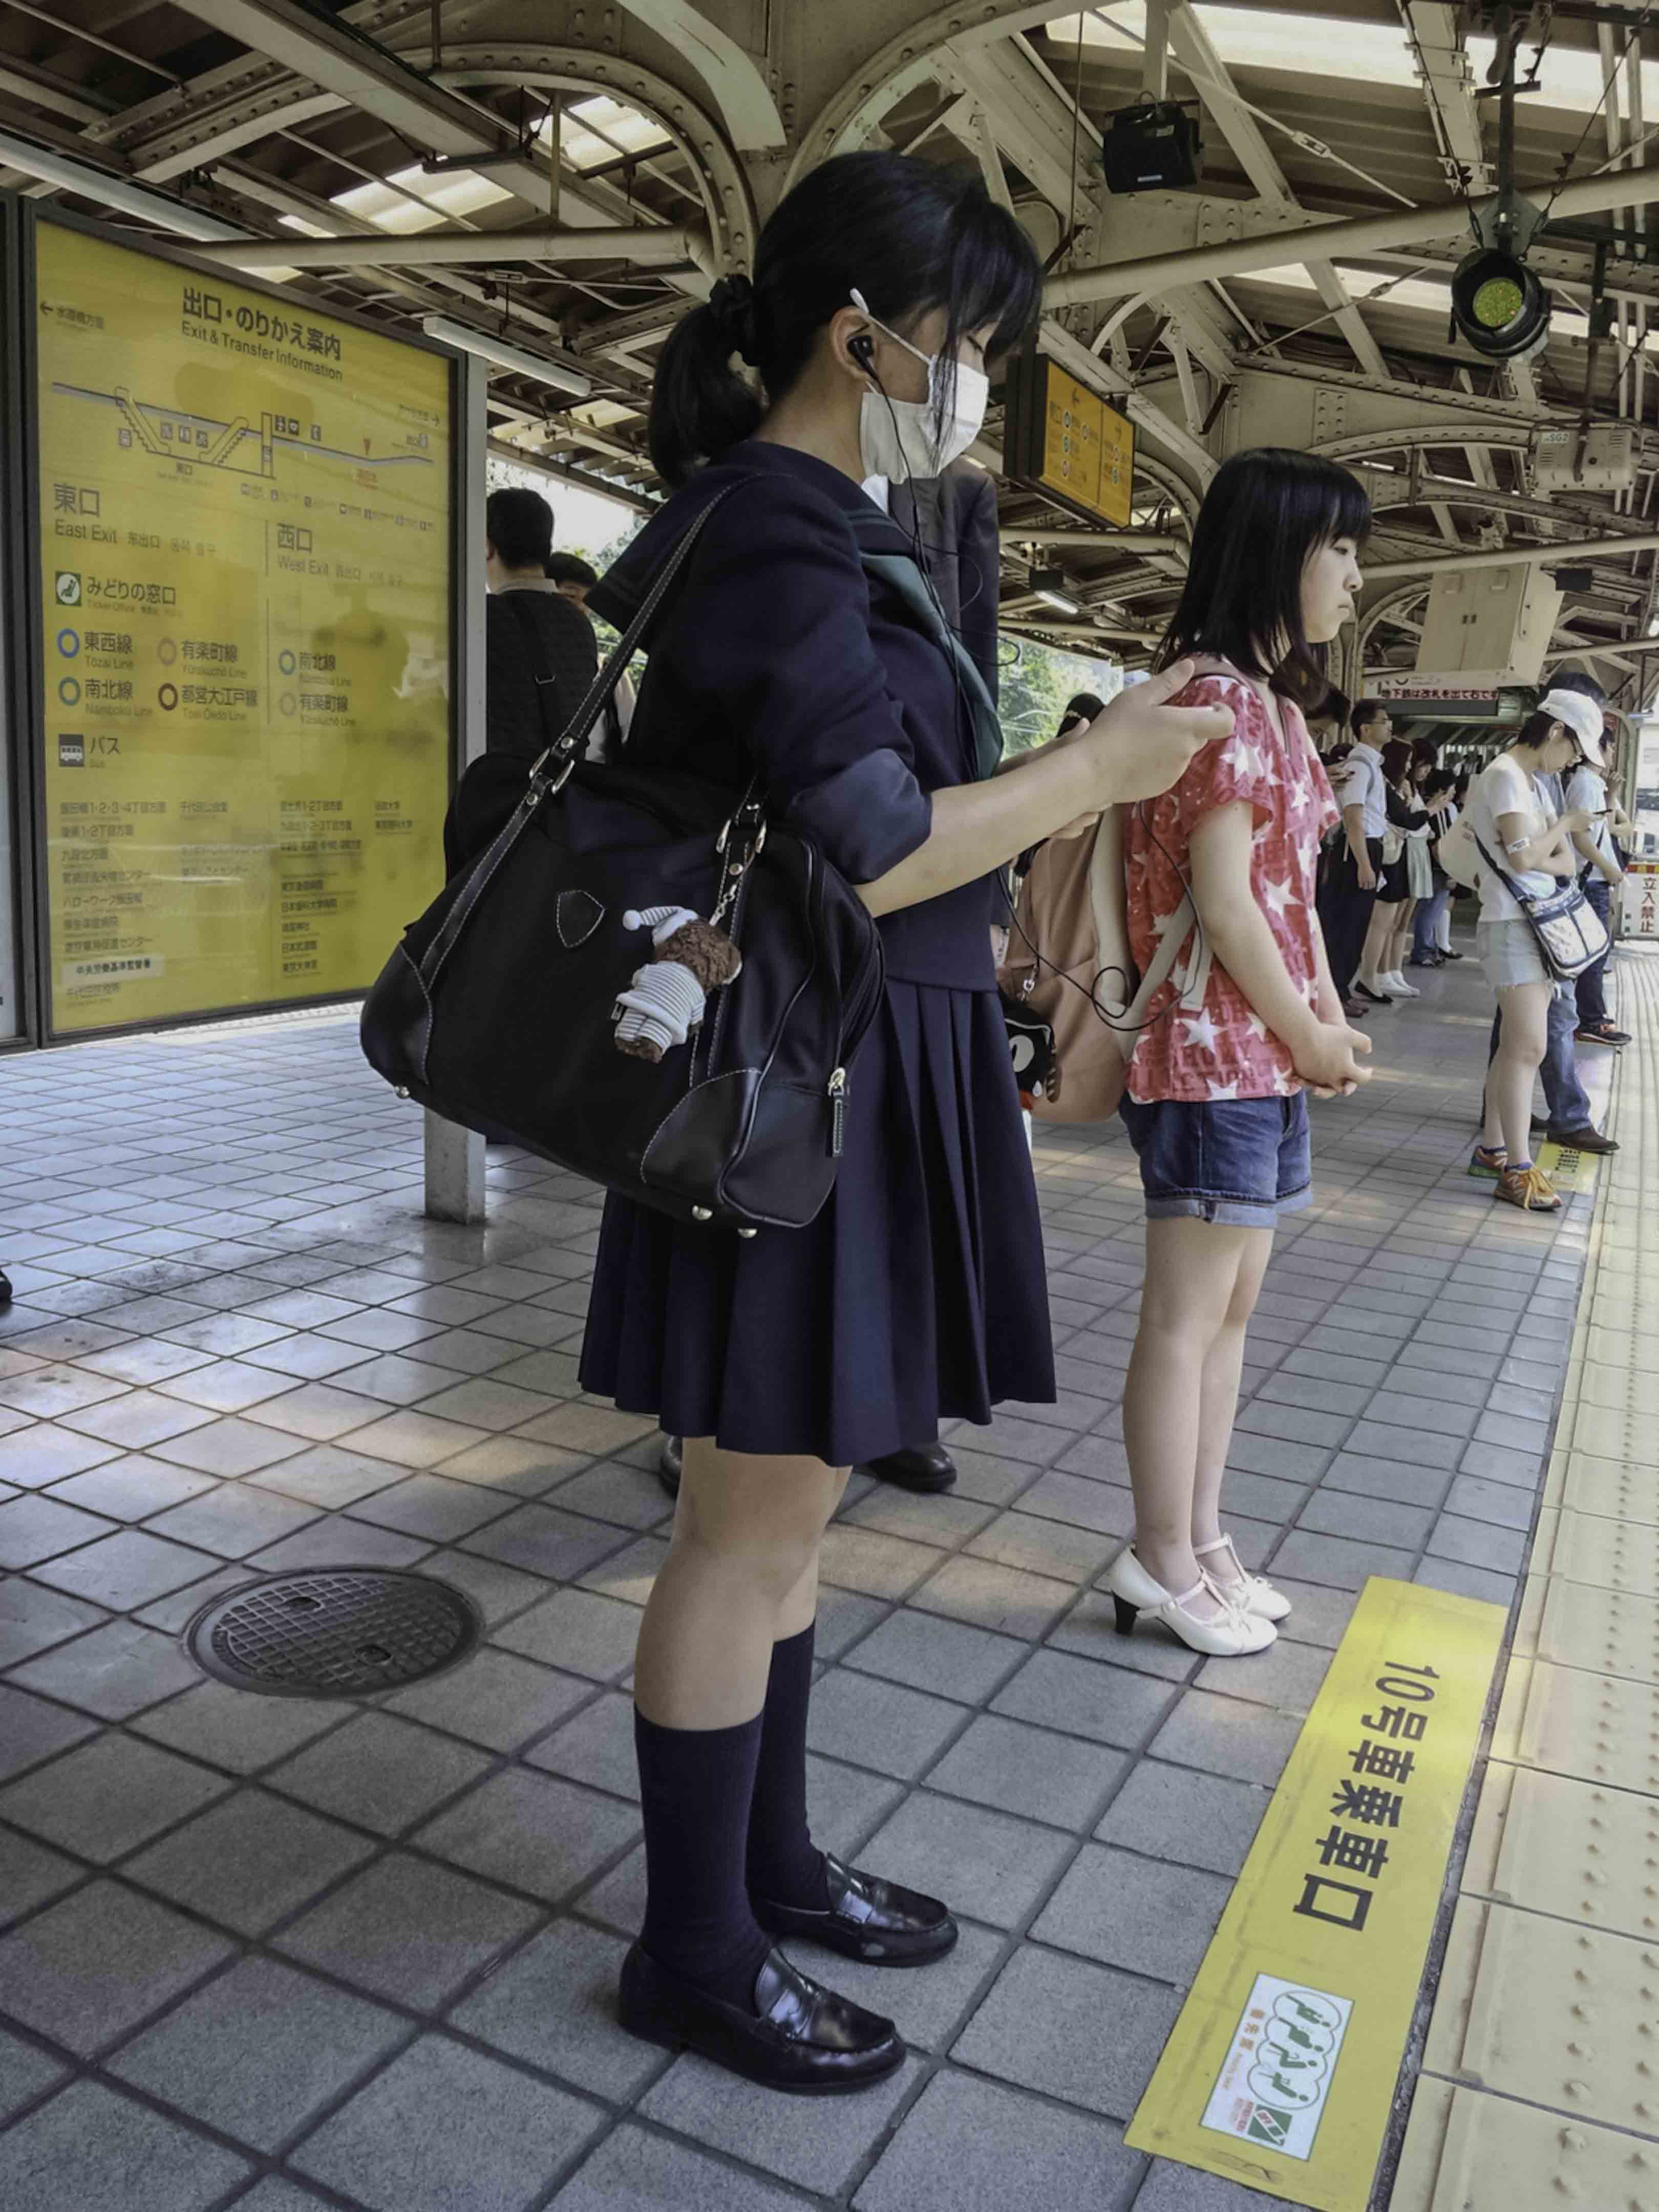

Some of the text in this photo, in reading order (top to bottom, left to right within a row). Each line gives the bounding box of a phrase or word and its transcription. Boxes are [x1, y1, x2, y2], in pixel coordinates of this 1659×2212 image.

[182, 287, 341, 361] 出口・のりかえ案内
[181, 320, 343, 381] Exit & Transfer Information
[54, 482, 101, 518] 東口
[55, 518, 118, 544] East Exit
[277, 521, 313, 555] 西口
[278, 554, 329, 577] West Exit
[87, 576, 176, 605] みどりの窓口
[83, 630, 133, 655] 東西線
[181, 639, 238, 663] 有楽町線
[299, 651, 336, 672] 南北線
[85, 677, 133, 701] 南北線
[181, 685, 258, 708] 都営大江戸線
[300, 693, 349, 713] 有楽町線
[89, 736, 121, 755] バス
[1640, 876, 1656, 934] 立入禁止
[1292, 1658, 1441, 1932] 10号車乗車口
